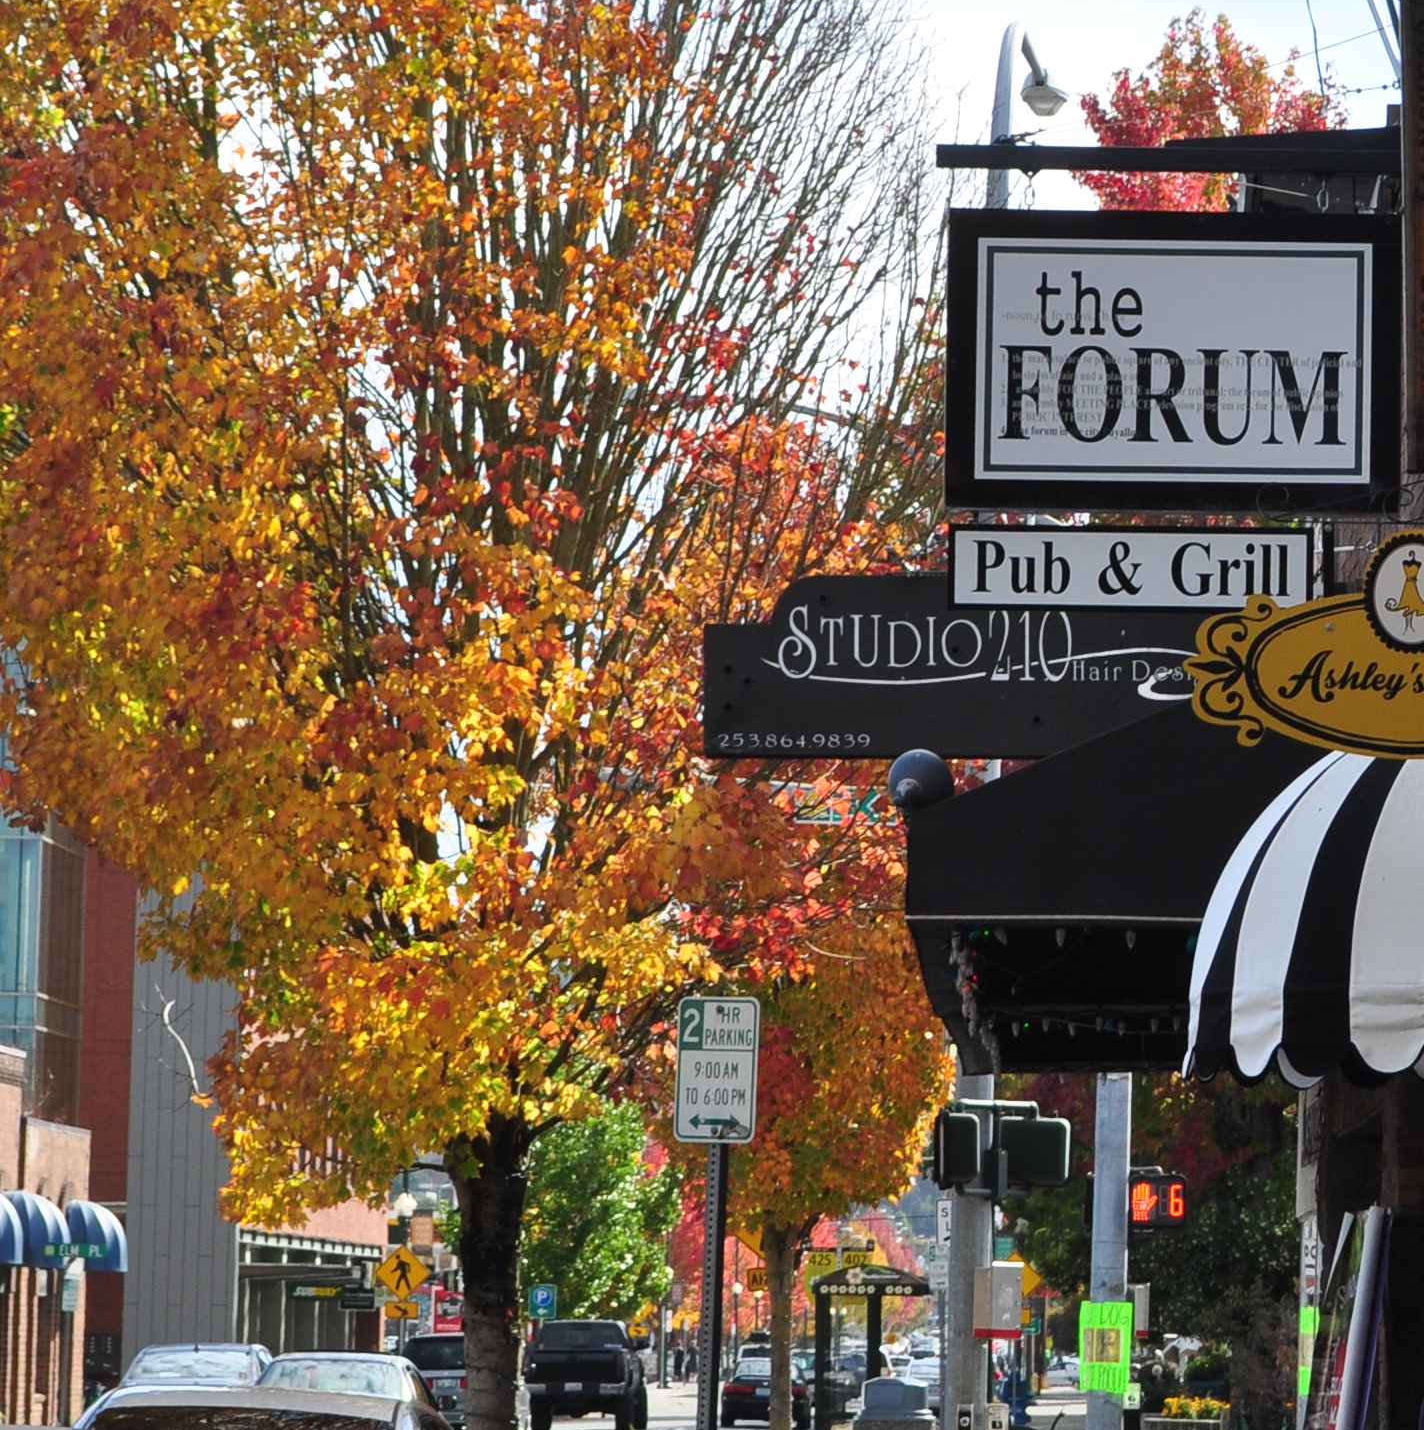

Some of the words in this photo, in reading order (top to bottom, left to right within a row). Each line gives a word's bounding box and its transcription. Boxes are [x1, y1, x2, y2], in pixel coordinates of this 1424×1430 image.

[1035, 270, 1143, 337] the
[998, 344, 1349, 446] FORUM
[971, 539, 1072, 595] Pub
[1098, 540, 1144, 596] &
[1171, 541, 1291, 597] Grill
[776, 604, 983, 680] STUDIO
[987, 610, 1073, 682] 210
[1072, 660, 1123, 682] Hair
[1130, 660, 1198, 682] Desi
[717, 733, 871, 749] 253.864.9839
[683, 1007, 701, 1043] 2
[721, 1006, 741, 1024] HR
[704, 1028, 753, 1047] PARKING
[694, 1061, 720, 1079] 9:00
[722, 1061, 739, 1079] AM
[685, 1087, 698, 1105] TO
[703, 1088, 729, 1106] 6:00
[731, 1088, 746, 1106] PM
[1169, 1183, 1184, 1217] 6
[58, 1244, 80, 1257] ELM
[88, 1245, 103, 1258] PL
[809, 1254, 832, 1267] 425
[844, 1254, 868, 1267] 402
[292, 1285, 342, 1298] SUBWAY
[1099, 1304, 1130, 1328] DOG
